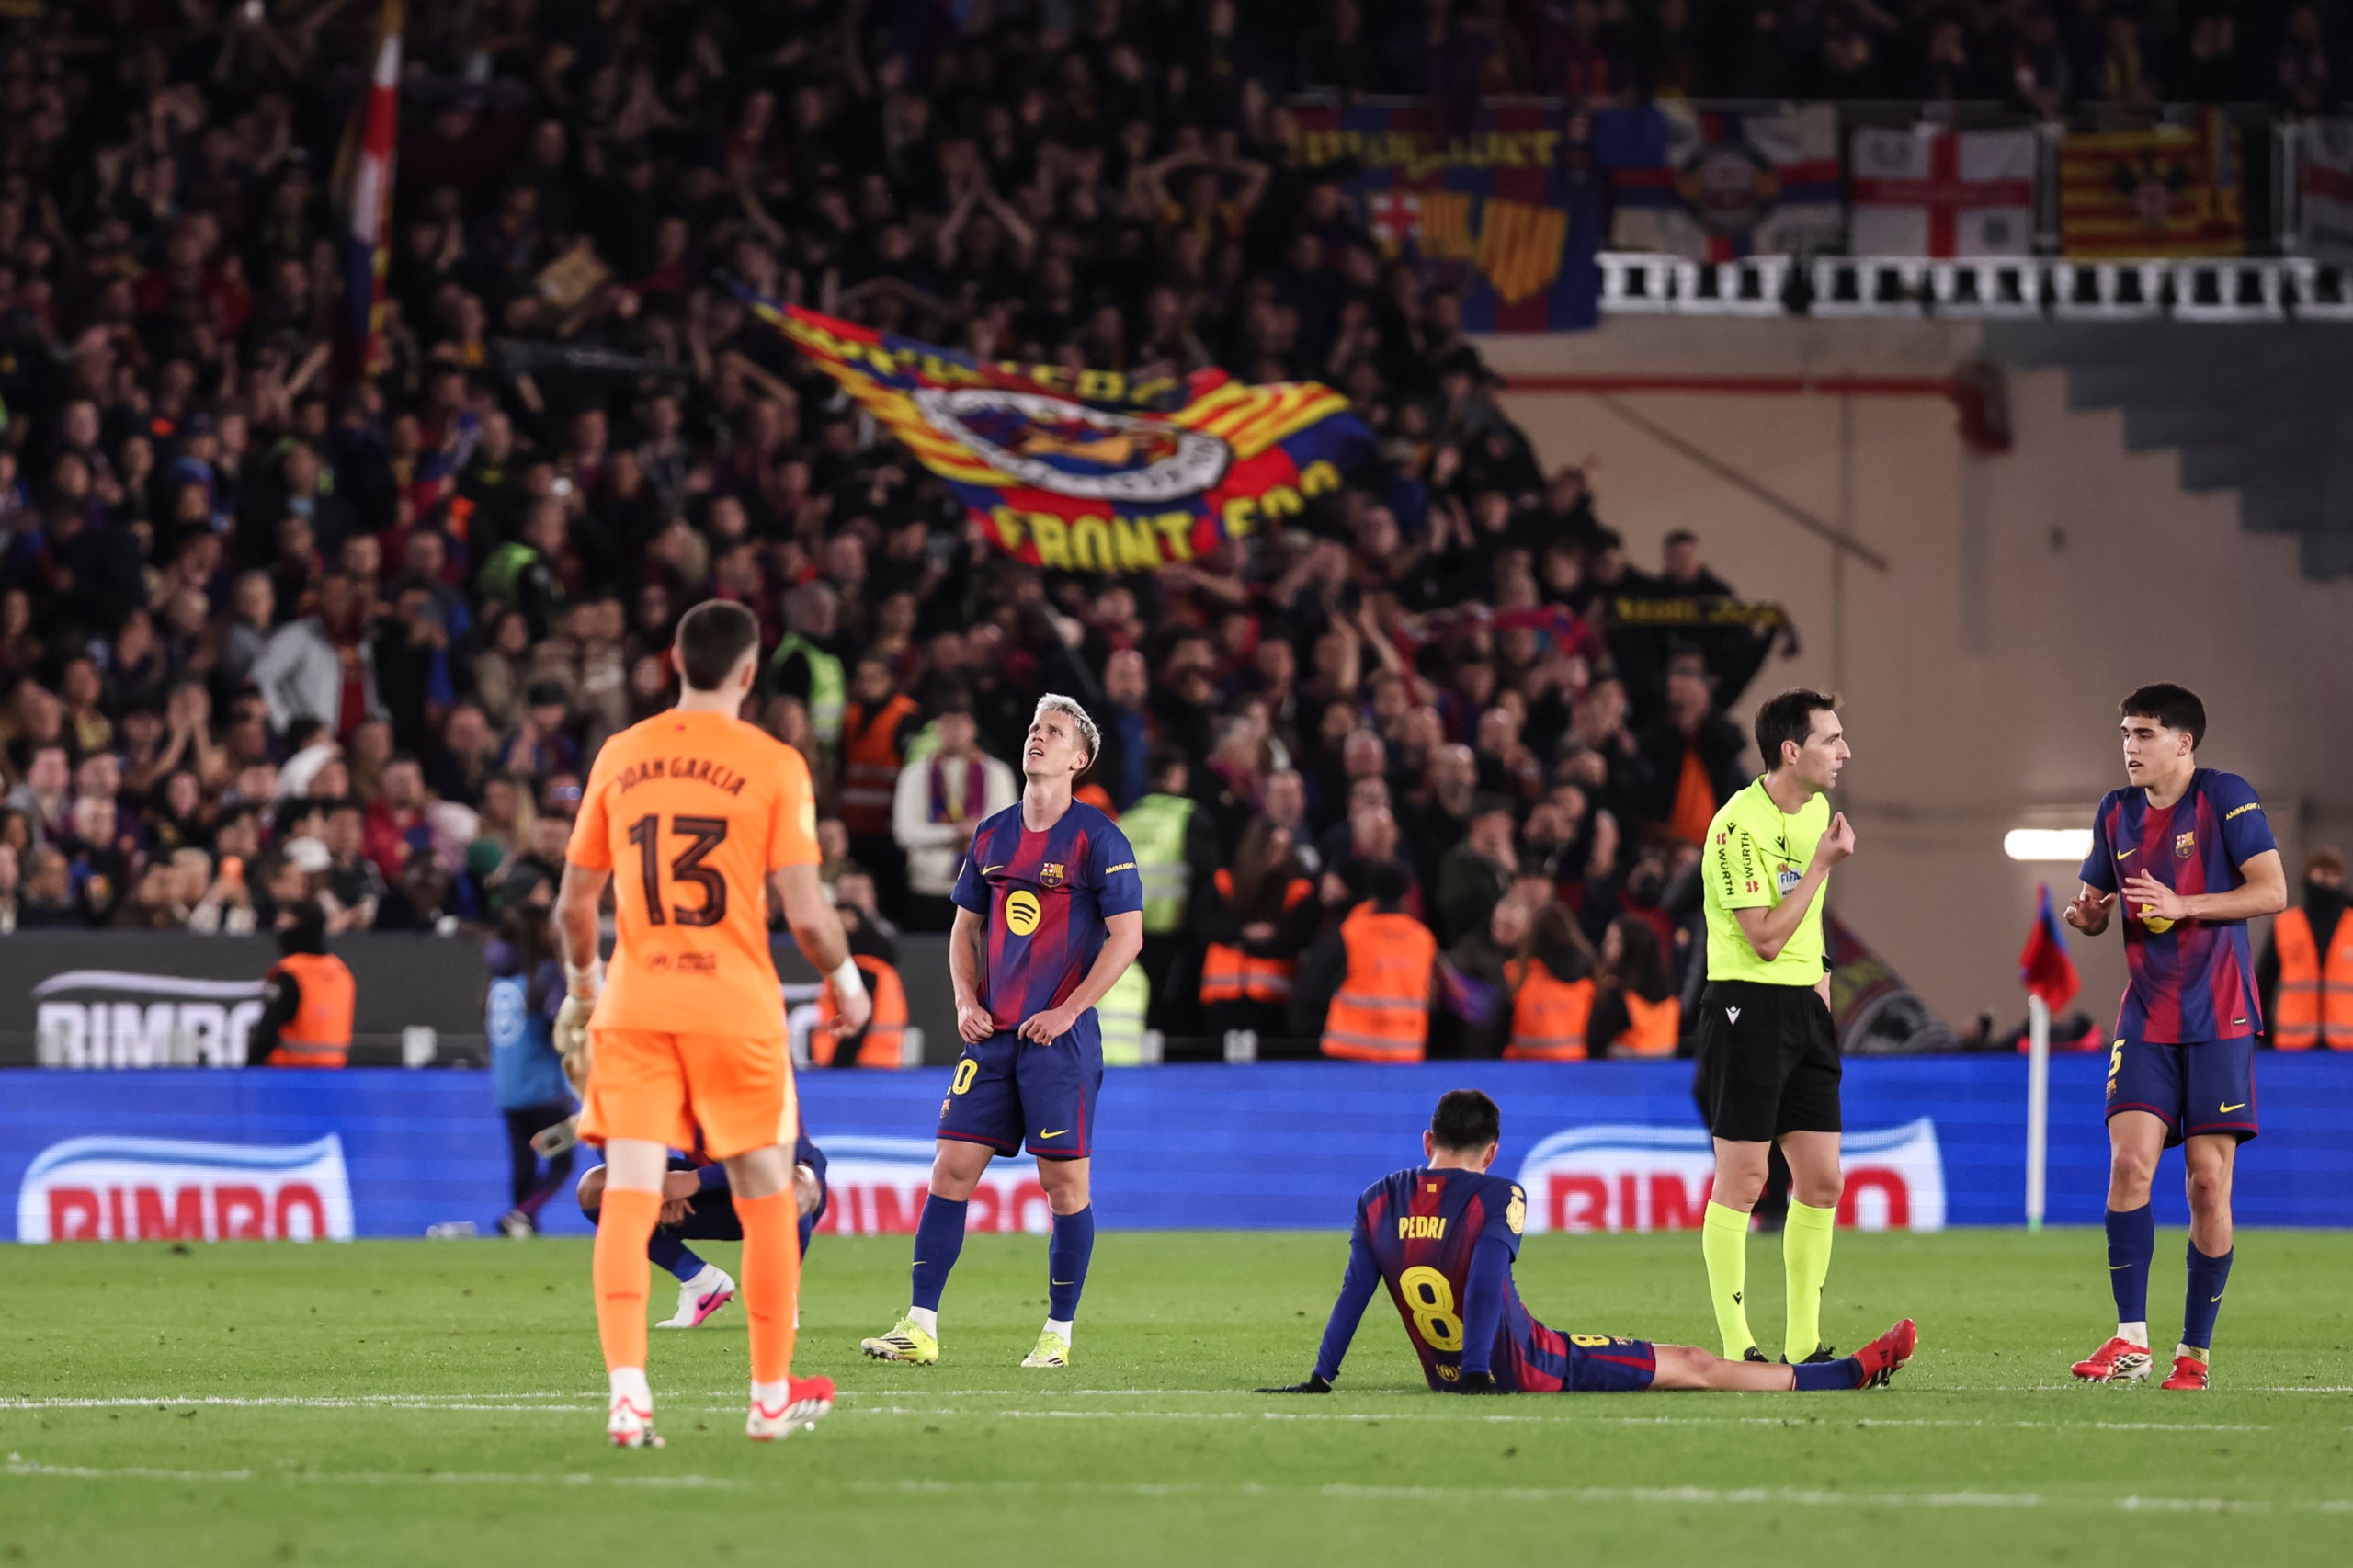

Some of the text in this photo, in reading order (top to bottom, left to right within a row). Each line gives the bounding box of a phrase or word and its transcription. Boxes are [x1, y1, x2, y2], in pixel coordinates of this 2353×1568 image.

[619, 757, 746, 796] JOAN GARCIA
[628, 813, 728, 927] 13
[1718, 848, 1734, 896] WÜRTH
[1741, 832, 1754, 879] WÜRTH
[1780, 872, 1801, 884] FIFA
[947, 1058, 978, 1096] 0
[1549, 1168, 1908, 1231] BIMO
[1399, 1215, 1448, 1240] PEDRI
[1400, 1266, 1463, 1352] 8
